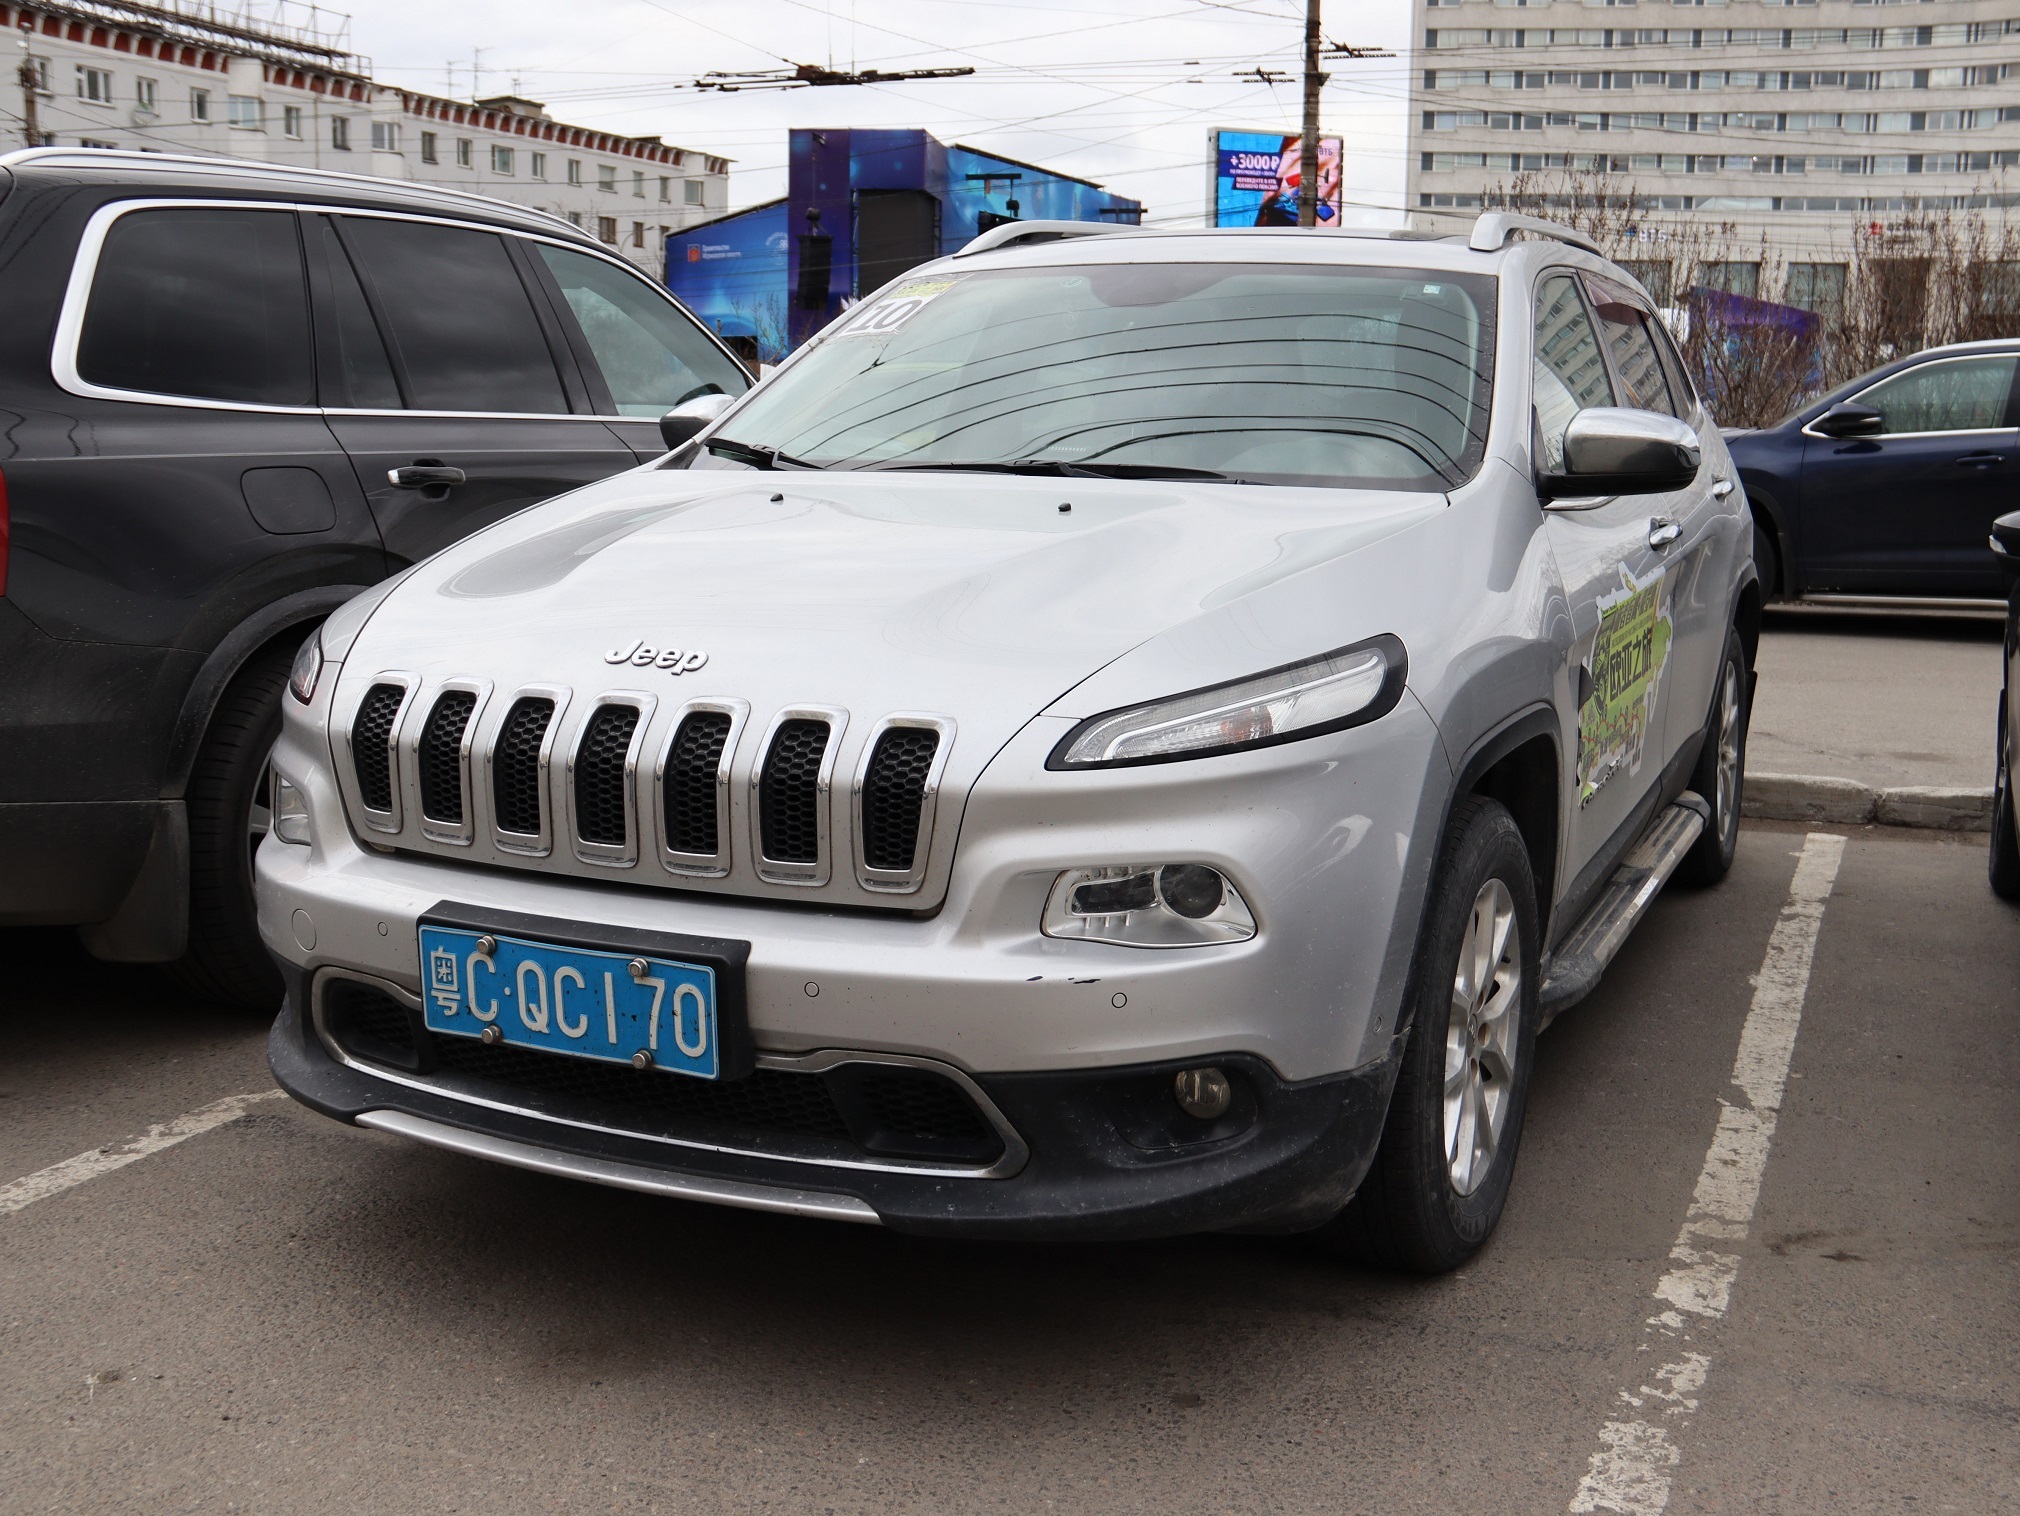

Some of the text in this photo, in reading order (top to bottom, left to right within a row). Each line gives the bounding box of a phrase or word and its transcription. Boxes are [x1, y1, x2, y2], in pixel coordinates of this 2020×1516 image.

[604, 639, 709, 676] Jeep
[1609, 625, 1653, 702] 欧亚之旅
